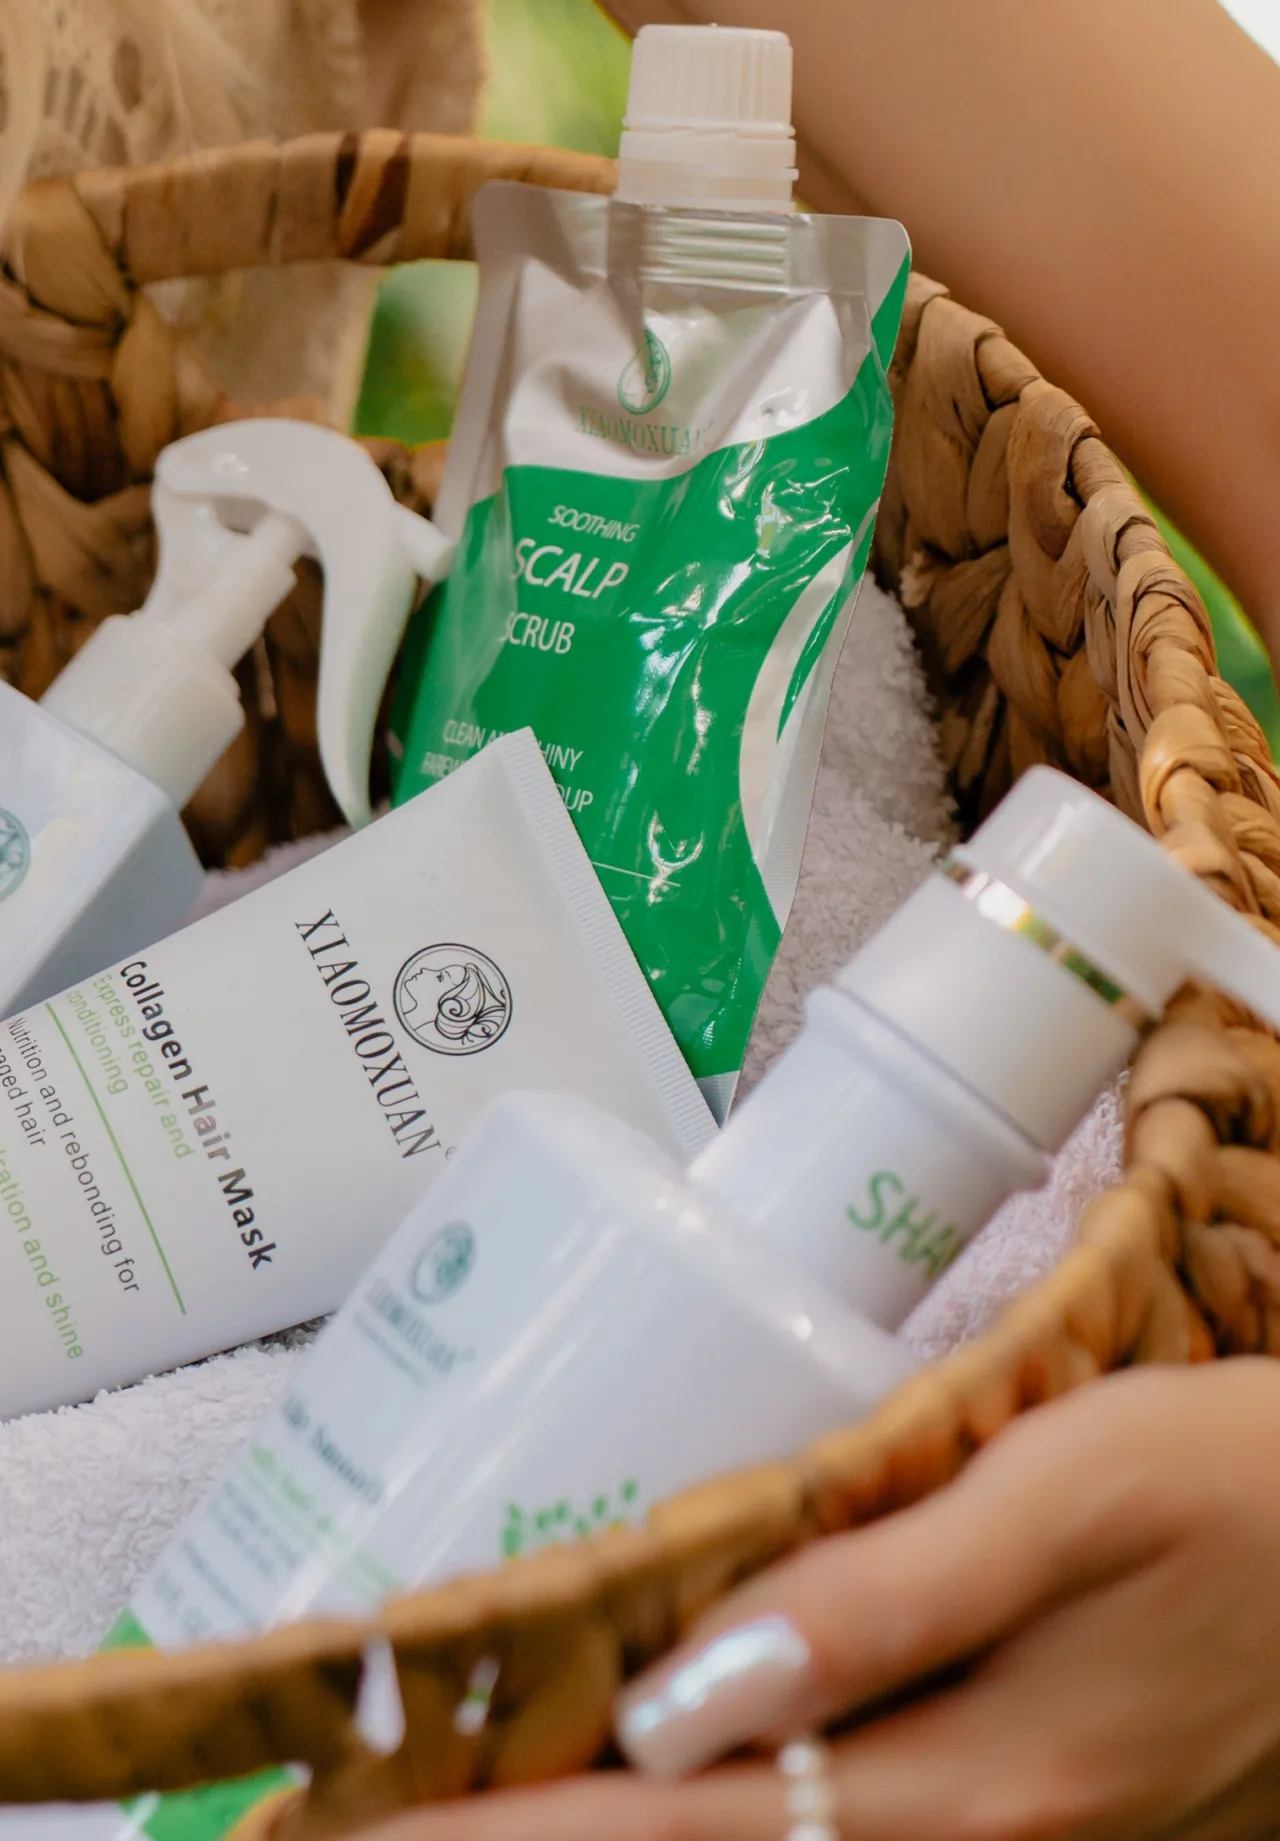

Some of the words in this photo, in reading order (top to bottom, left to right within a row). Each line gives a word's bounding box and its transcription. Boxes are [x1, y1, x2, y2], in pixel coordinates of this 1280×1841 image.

[509, 537, 630, 599] SCALP
[547, 504, 640, 543] SOOTHING
[499, 611, 575, 654] SCRUB
[442, 718, 486, 749] CLEAN
[538, 740, 584, 772] HINY
[92, 974, 136, 1039] Express
[126, 1039, 171, 1107] repair
[160, 1110, 196, 1160] and
[294, 908, 442, 1159] XIAOMOXUAN
[7, 1016, 48, 1082] Nutrition
[39, 1085, 74, 1128] and
[59, 1131, 124, 1257] rebonding
[113, 1257, 140, 1294] for
[14, 1101, 46, 1147] hair
[119, 960, 193, 1081] Collagen
[181, 1084, 232, 1161] Hair
[216, 1166, 278, 1270] Mask
[23, 1238, 61, 1288] and
[45, 1291, 84, 1360] shine
